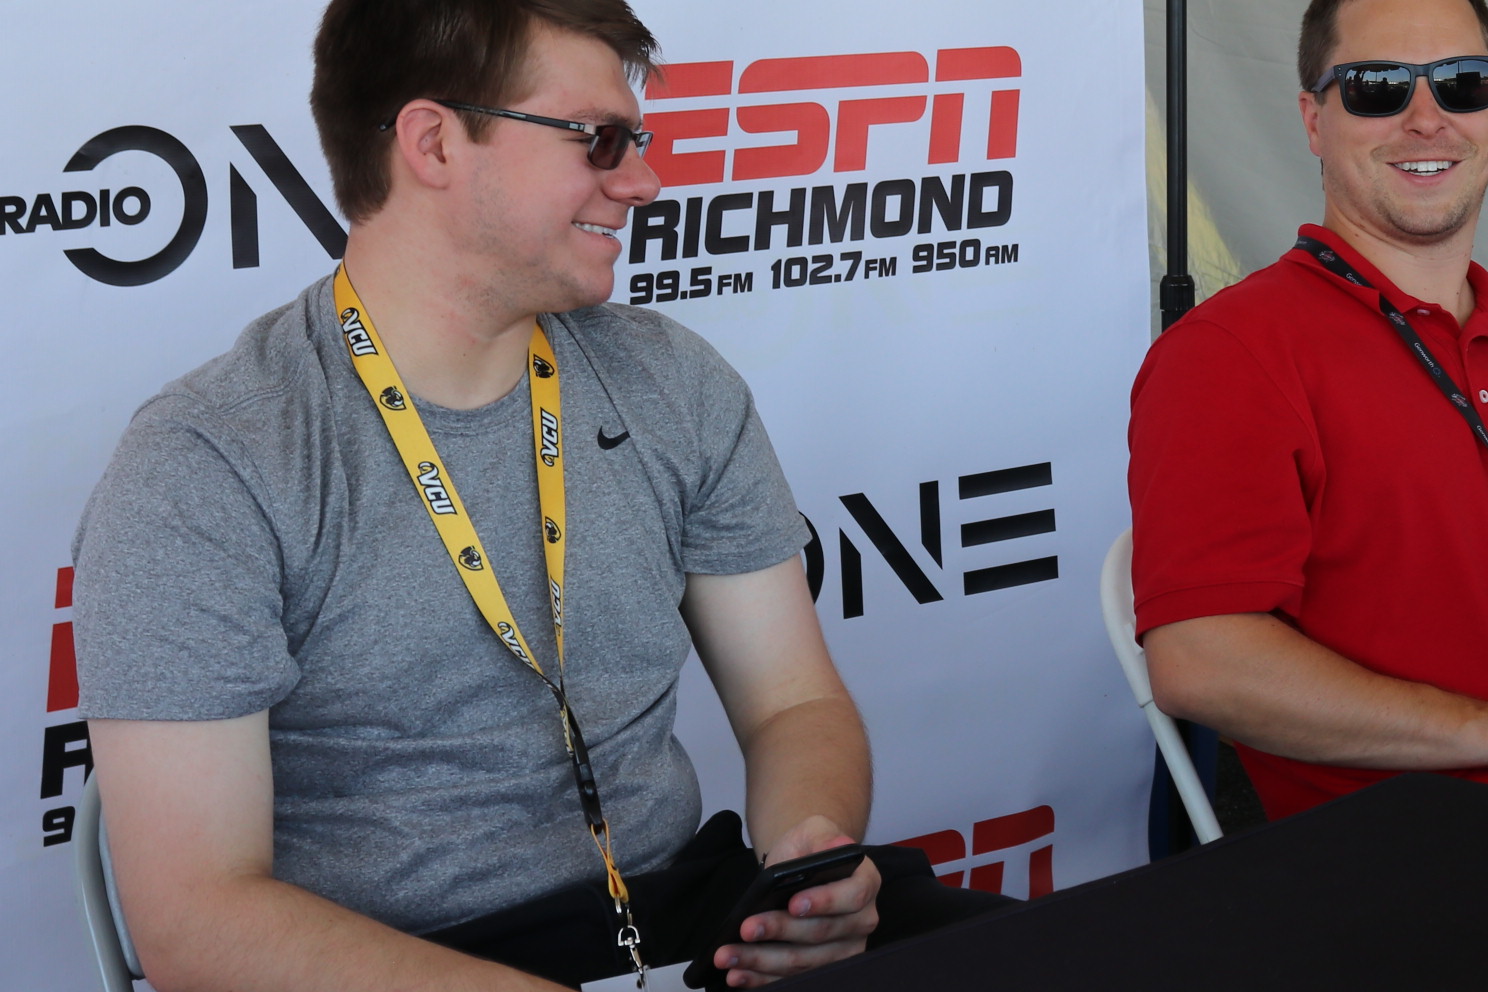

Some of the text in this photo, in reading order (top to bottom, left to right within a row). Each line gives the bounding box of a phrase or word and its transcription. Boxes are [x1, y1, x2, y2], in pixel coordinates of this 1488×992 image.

[640, 45, 1022, 188] ESPN
[0, 186, 151, 235] RADIO
[628, 170, 1014, 265] RICHMOND
[341, 307, 379, 356] VCU
[1414, 342, 1434, 368] Genworth
[540, 407, 560, 467] VCU
[417, 461, 457, 515] VCU
